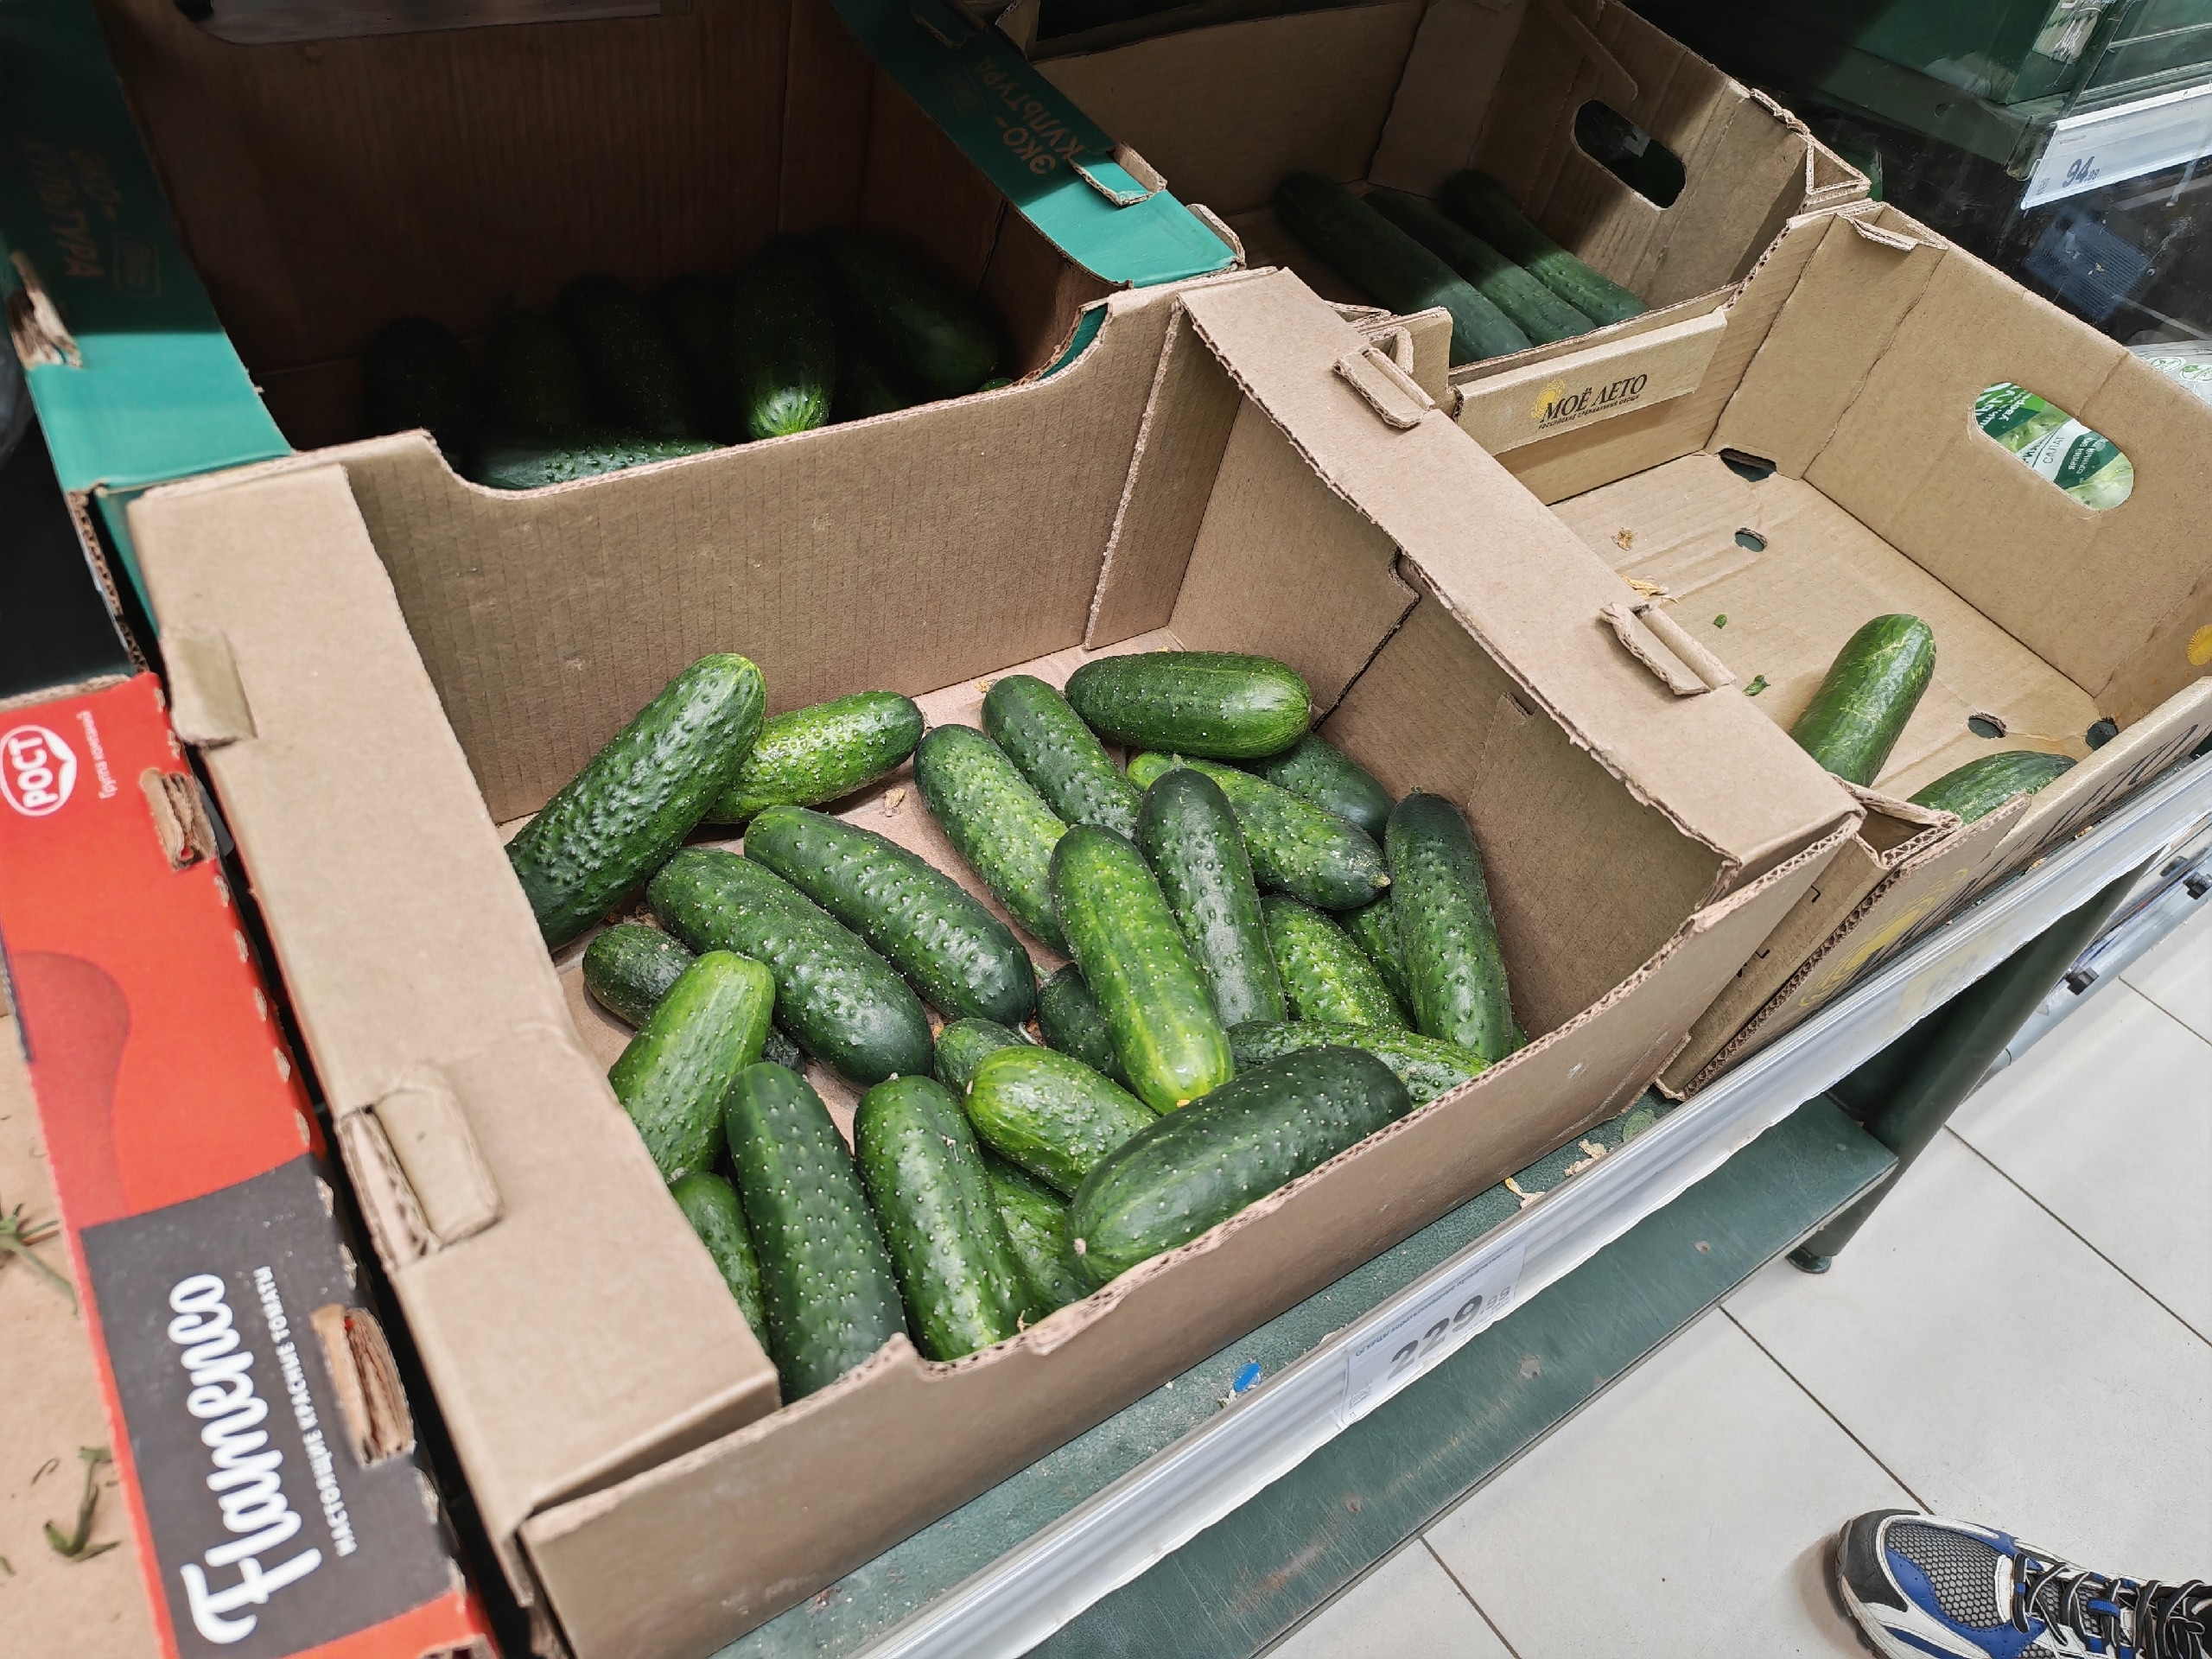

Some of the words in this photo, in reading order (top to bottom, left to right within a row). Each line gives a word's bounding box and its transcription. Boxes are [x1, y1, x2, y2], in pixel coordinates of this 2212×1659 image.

[973, 55, 1085, 161] КУЛЬТУРА
[993, 115, 1057, 175] ЭКО-
[1539, 386, 1592, 423] МОЁ
[1591, 373, 1648, 406] ЛЕТО
[2043, 435, 2065, 464] САЛАТ
[2068, 445, 2085, 470] ЯРКИЙ
[2075, 447, 2096, 474] СОЧНЫЙ
[76, 710, 105, 761] компаний
[8, 736, 60, 808] РОСТ
[94, 760, 118, 799] Группа
[252, 1265, 290, 1343] ТОМАТЫ
[276, 1341, 318, 1430] КРАСНЫЕ
[167, 1274, 323, 1644] Flamenco
[302, 1428, 358, 1557] НАСТОЯЩИЕ
